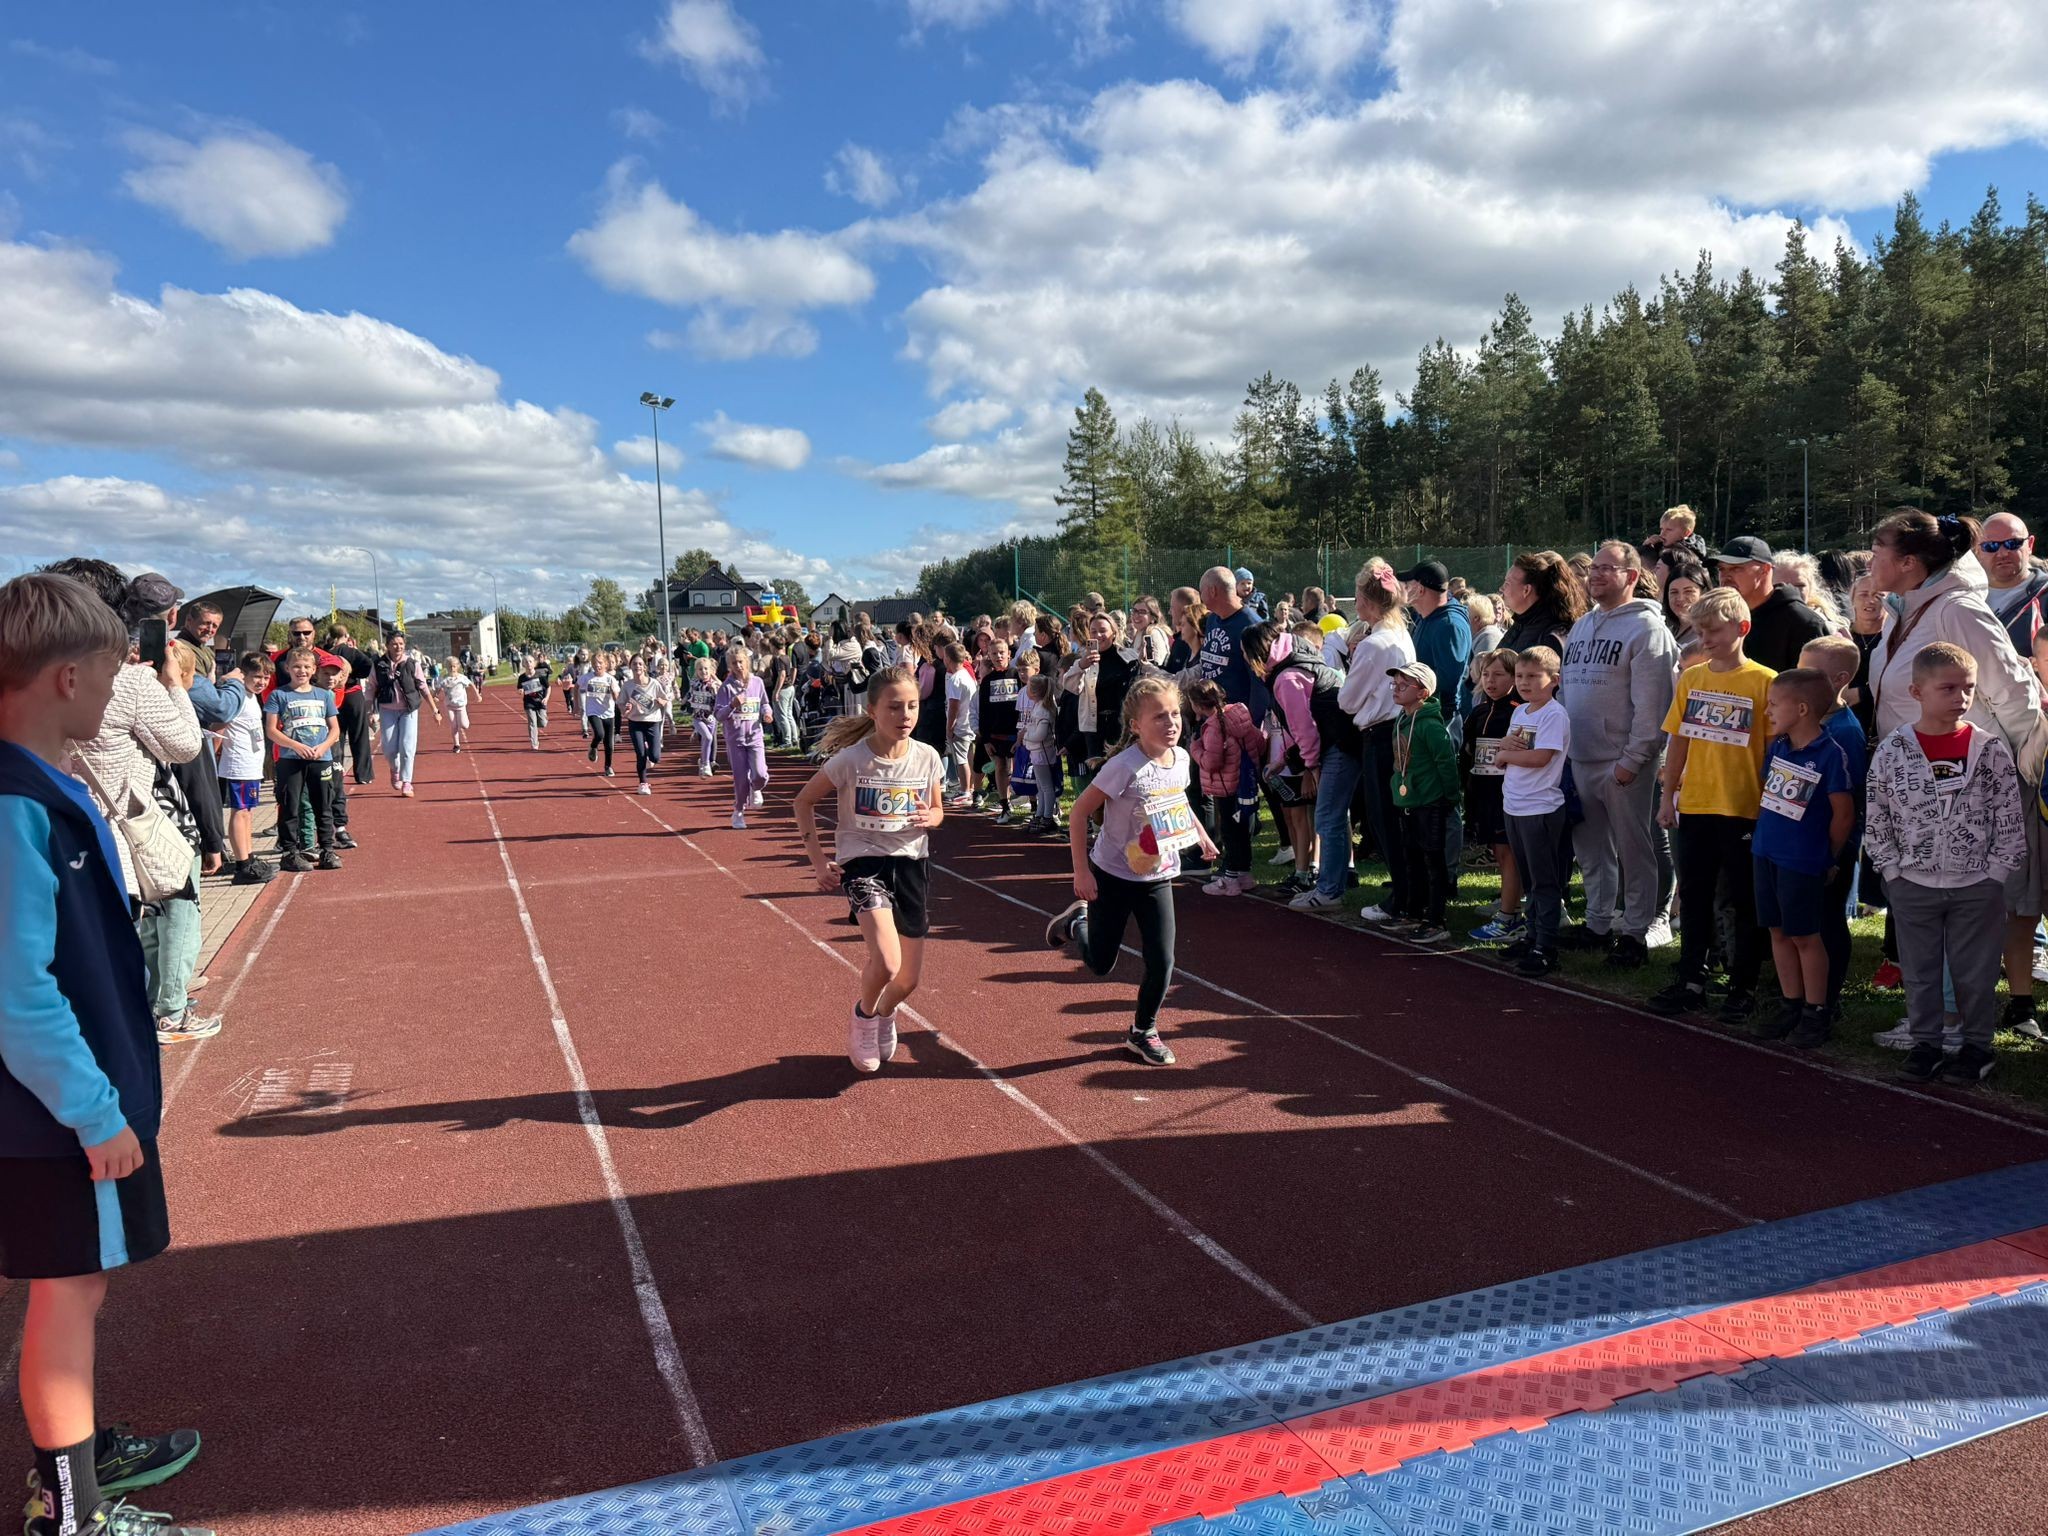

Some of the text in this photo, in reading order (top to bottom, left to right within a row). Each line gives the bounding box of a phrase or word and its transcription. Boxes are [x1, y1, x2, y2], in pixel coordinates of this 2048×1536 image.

[1584, 638, 1623, 667] STAR
[994, 684, 1014, 695] 200
[1694, 704, 1742, 729] 454
[1764, 770, 1799, 799] 286
[1952, 823, 1979, 847] YORK
